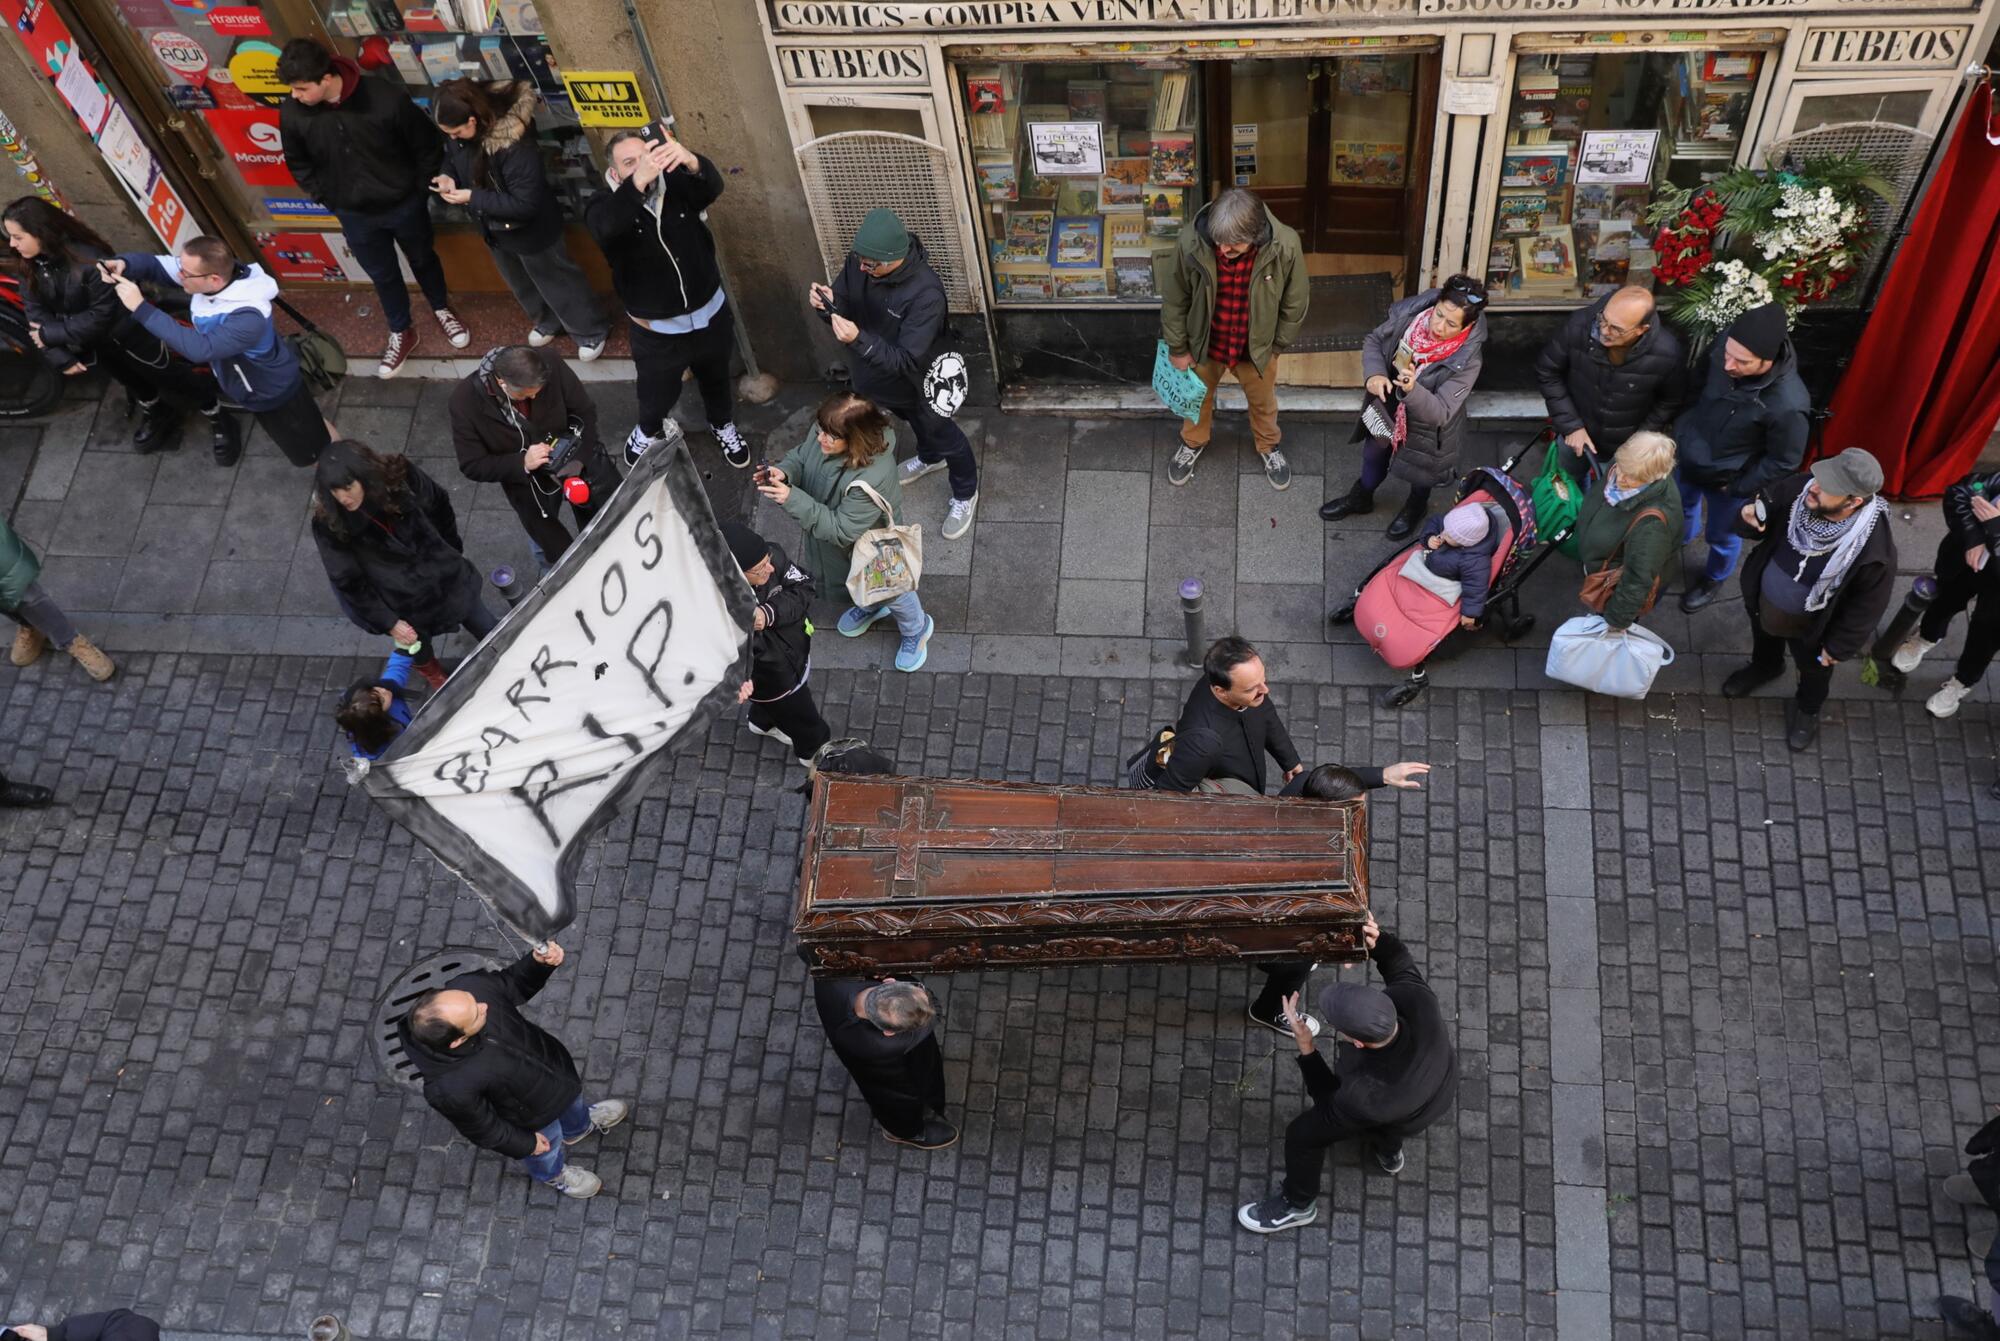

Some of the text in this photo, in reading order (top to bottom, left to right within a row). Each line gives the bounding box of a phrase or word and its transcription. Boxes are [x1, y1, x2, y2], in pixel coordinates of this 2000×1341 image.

[781, 3, 904, 27] COMICS
[924, 1, 1060, 26] COMPRA
[1070, 0, 1185, 20] VENTA
[1809, 30, 1960, 62] TEBEOS
[783, 49, 922, 78] TEBEOS
[579, 83, 629, 101] WU
[234, 152, 286, 165] Money
[158, 198, 177, 236] ria
[434, 512, 664, 794] BARRIOS
